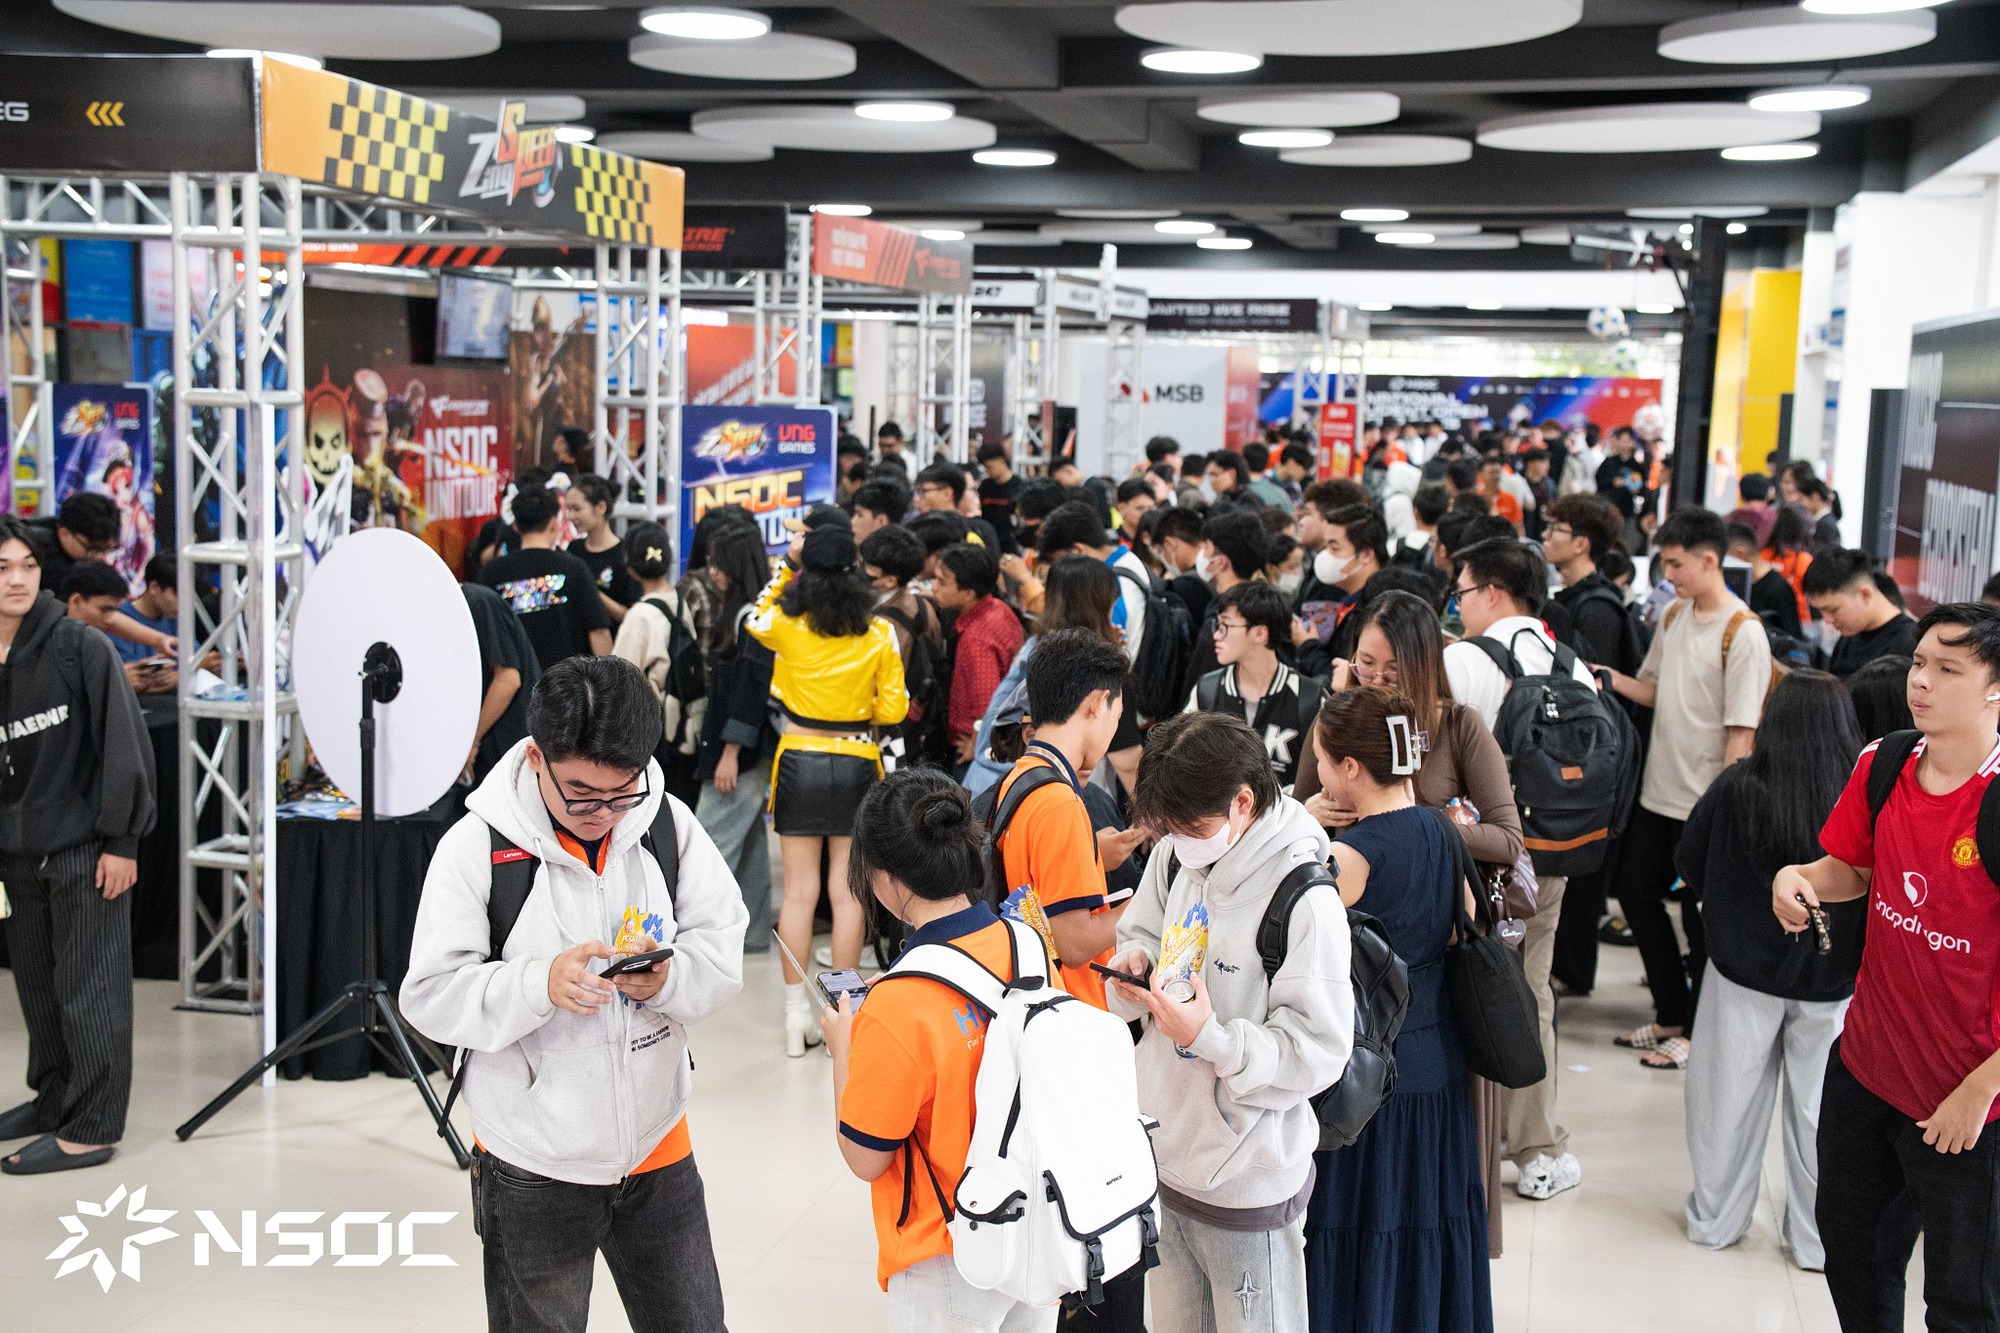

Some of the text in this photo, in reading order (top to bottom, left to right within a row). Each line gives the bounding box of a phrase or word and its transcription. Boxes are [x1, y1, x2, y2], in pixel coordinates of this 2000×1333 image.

[1155, 384, 1204, 403] MSB
[777, 441, 816, 454] GAMES
[778, 424, 816, 442] VNG
[424, 425, 498, 479] NSOC
[424, 477, 498, 520] UNITOUR
[1264, 724, 1299, 764] K
